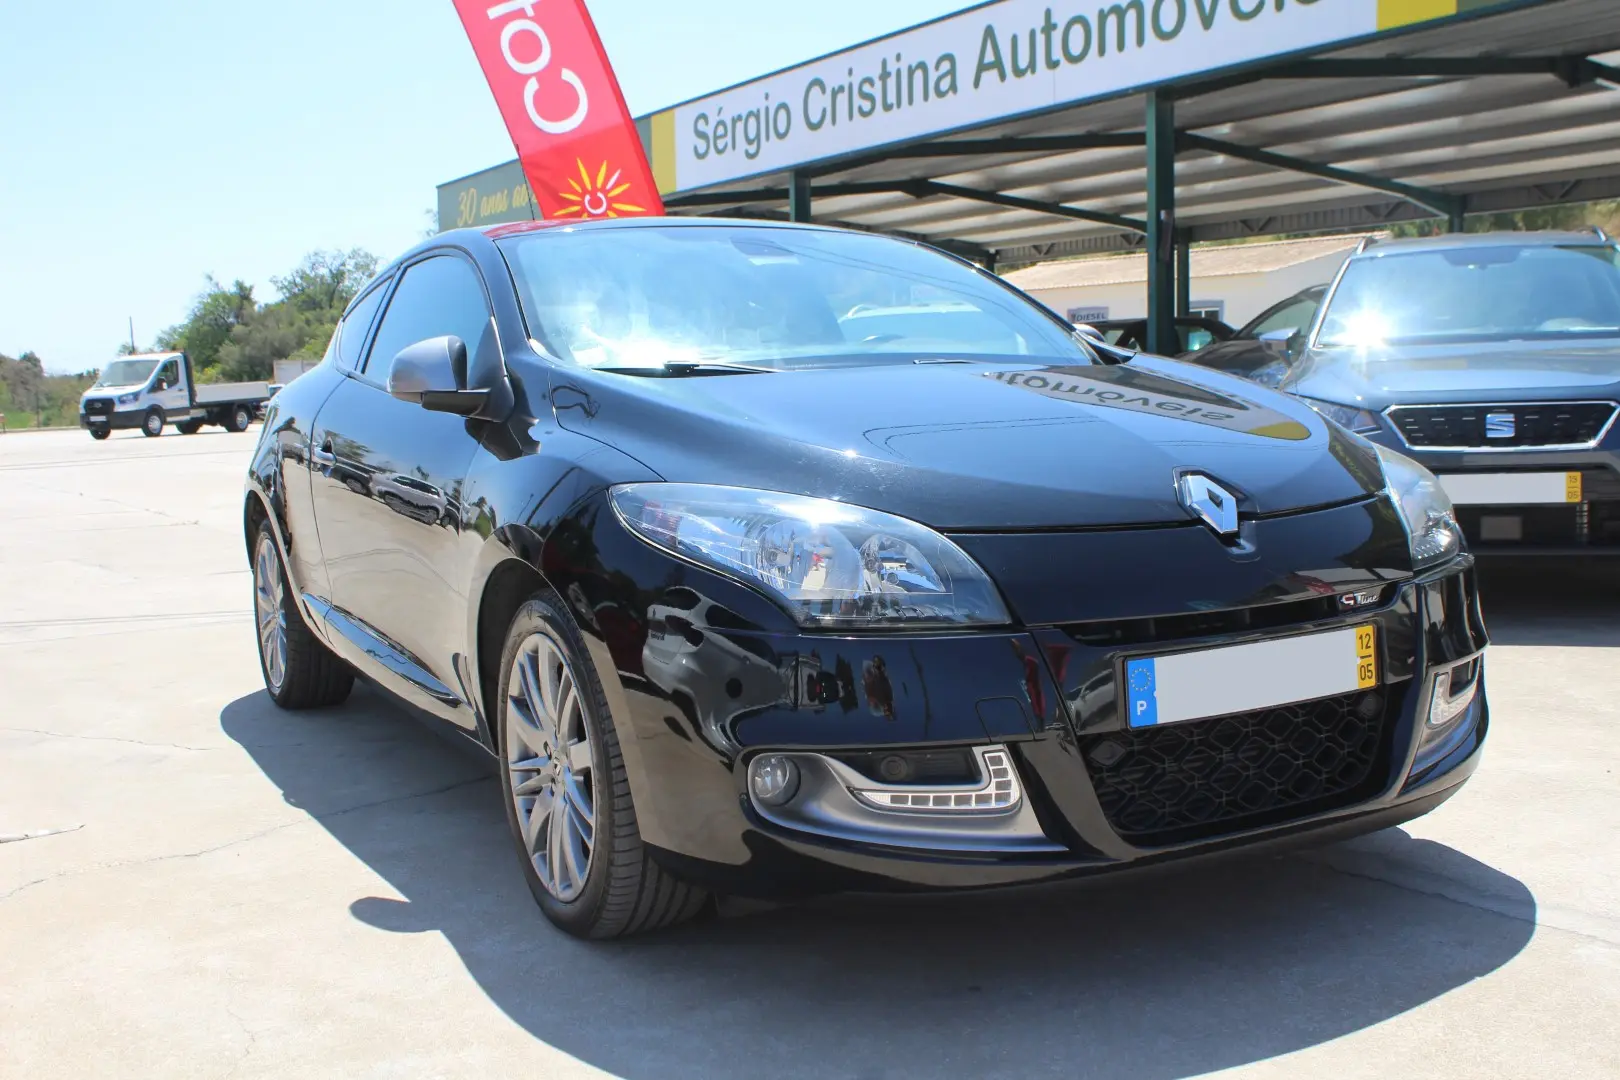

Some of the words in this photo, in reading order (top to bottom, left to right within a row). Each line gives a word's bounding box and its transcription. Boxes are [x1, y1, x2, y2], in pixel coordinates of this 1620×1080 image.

[693, 92, 792, 160] Sérgio
[803, 53, 957, 131] Cristina
[457, 188, 477, 227] 30
[480, 189, 508, 217] anos
[1358, 632, 1371, 650] 12
[1359, 663, 1373, 681] 05
[1136, 700, 1147, 716] P
